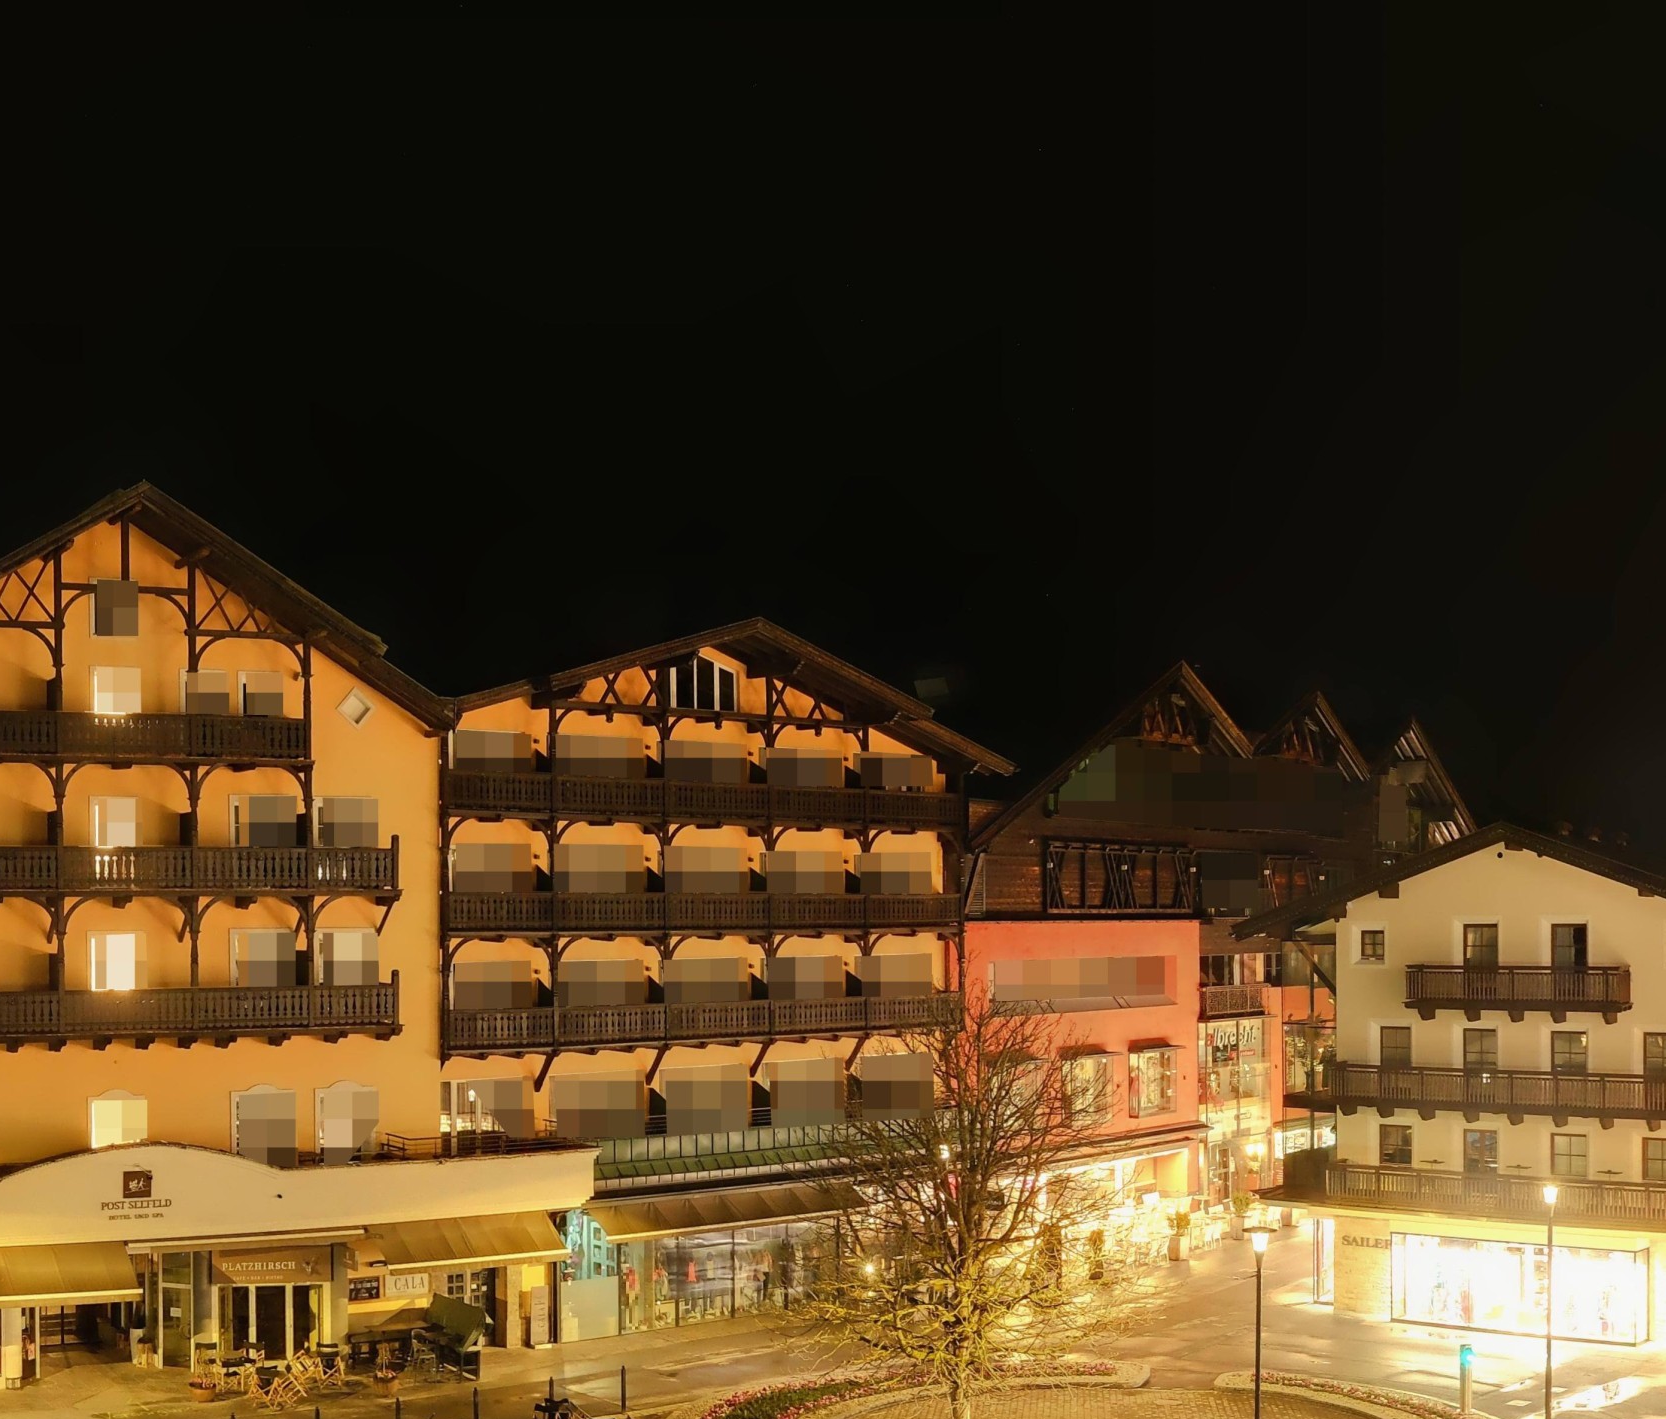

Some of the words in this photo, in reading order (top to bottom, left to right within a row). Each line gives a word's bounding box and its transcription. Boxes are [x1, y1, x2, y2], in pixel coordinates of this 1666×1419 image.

[100, 1201, 126, 1211] POST
[128, 1198, 172, 1210] SEEFELD
[222, 1261, 296, 1272] PLATZHIRSCH
